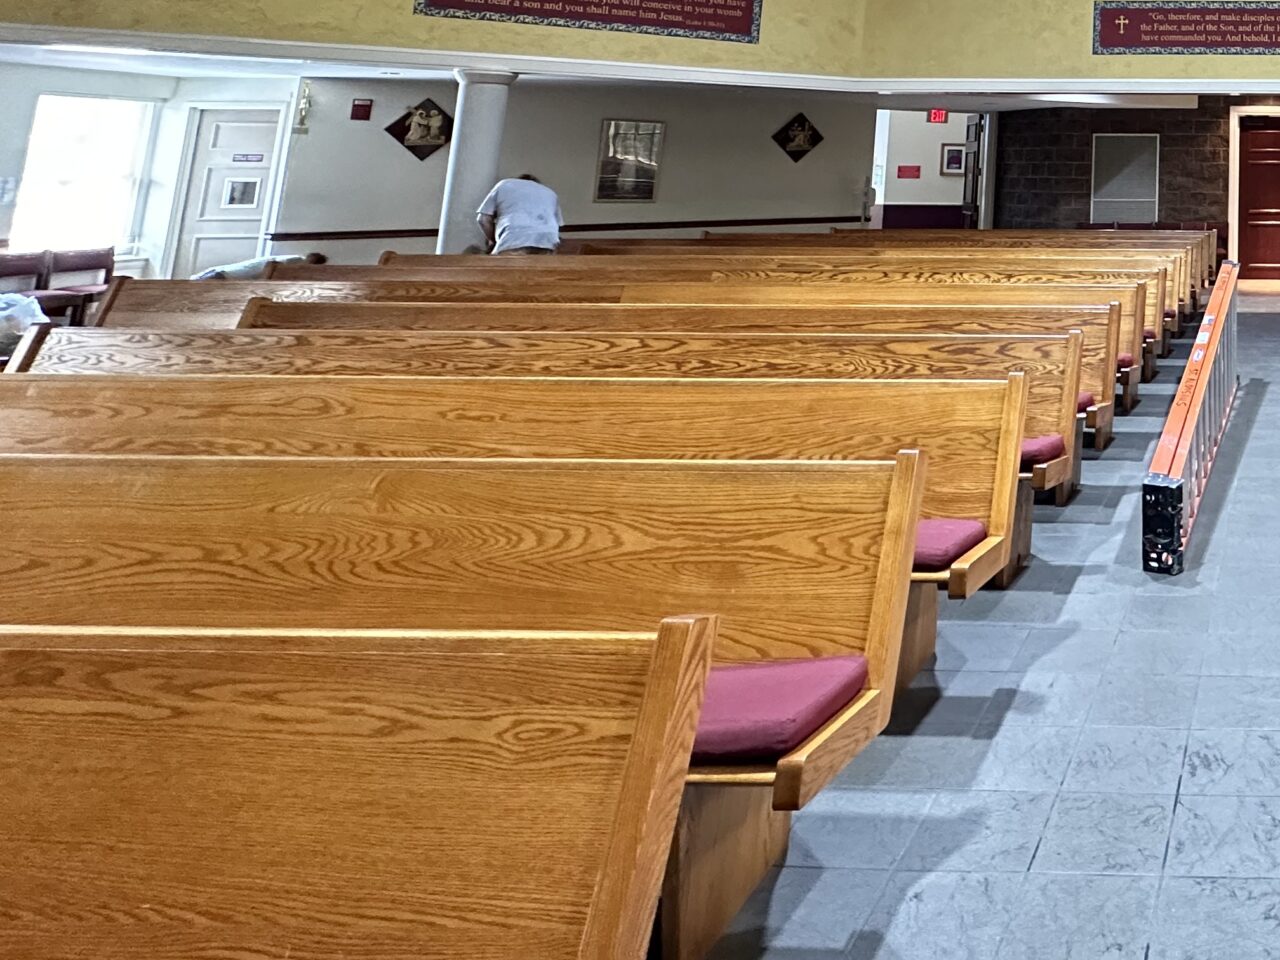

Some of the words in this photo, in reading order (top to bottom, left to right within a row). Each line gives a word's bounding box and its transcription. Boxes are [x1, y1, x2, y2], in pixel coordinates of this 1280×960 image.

[543, 2, 562, 10] and
[564, 4, 584, 13] you
[586, 5, 609, 14] shall
[612, 8, 636, 16] name
[640, 10, 656, 18] him
[642, 1, 682, 10] conceive
[694, 6, 714, 14] your
[716, 8, 742, 16] womb
[1242, 13, 1274, 23] disciples
[1140, 23, 1152, 31] the
[1196, 23, 1206, 31] of
[1206, 23, 1218, 31] the
[931, 110, 946, 122] EXIT
